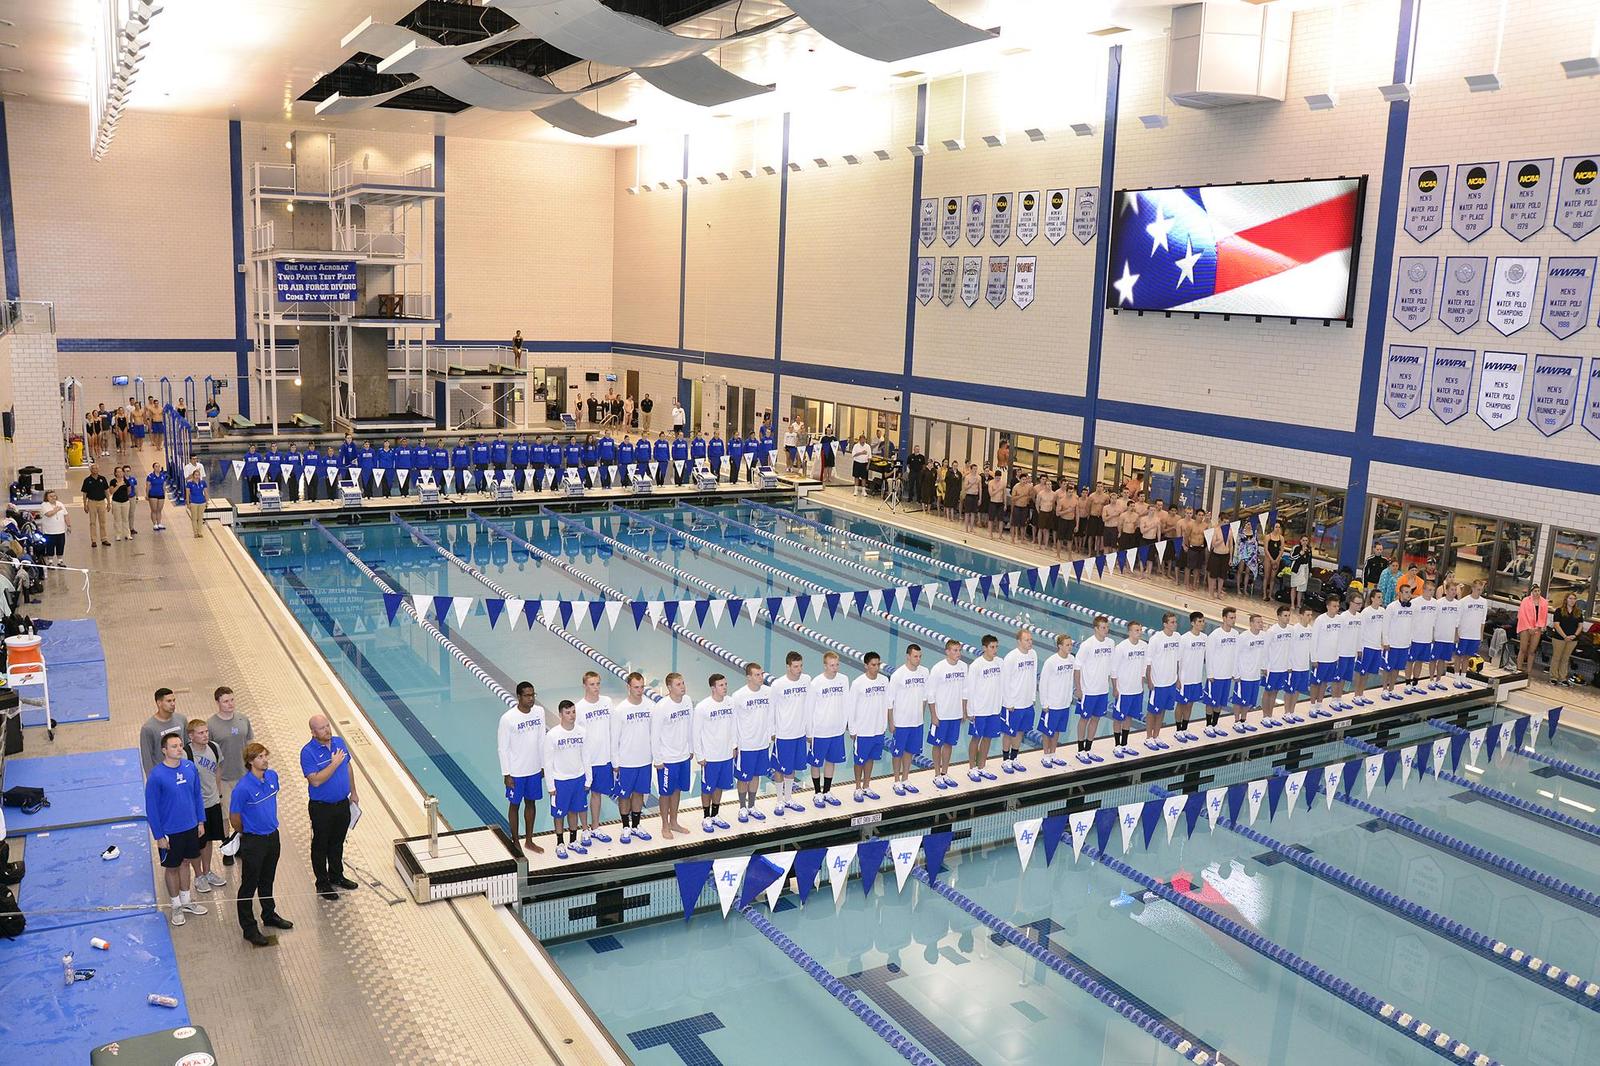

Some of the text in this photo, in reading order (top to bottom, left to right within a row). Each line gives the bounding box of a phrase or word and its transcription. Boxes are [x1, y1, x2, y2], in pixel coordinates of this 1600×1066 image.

[1550, 268, 1586, 277] WWPA
[1390, 355, 1419, 364] WWPA
[1436, 358, 1466, 367] WWPA
[1484, 362, 1518, 371] WWPA
[1536, 366, 1572, 376] WWPA
[1537, 407, 1566, 415] RUNNER-UP
[526, 719, 540, 727] FORCE
[198, 757, 209, 768] AIR
[1169, 807, 1179, 819] AF
[1124, 814, 1135, 828] AF
[1075, 822, 1087, 836] AF
[1021, 830, 1033, 844] AF
[834, 856, 847, 872] AF
[721, 871, 738, 886] AF
